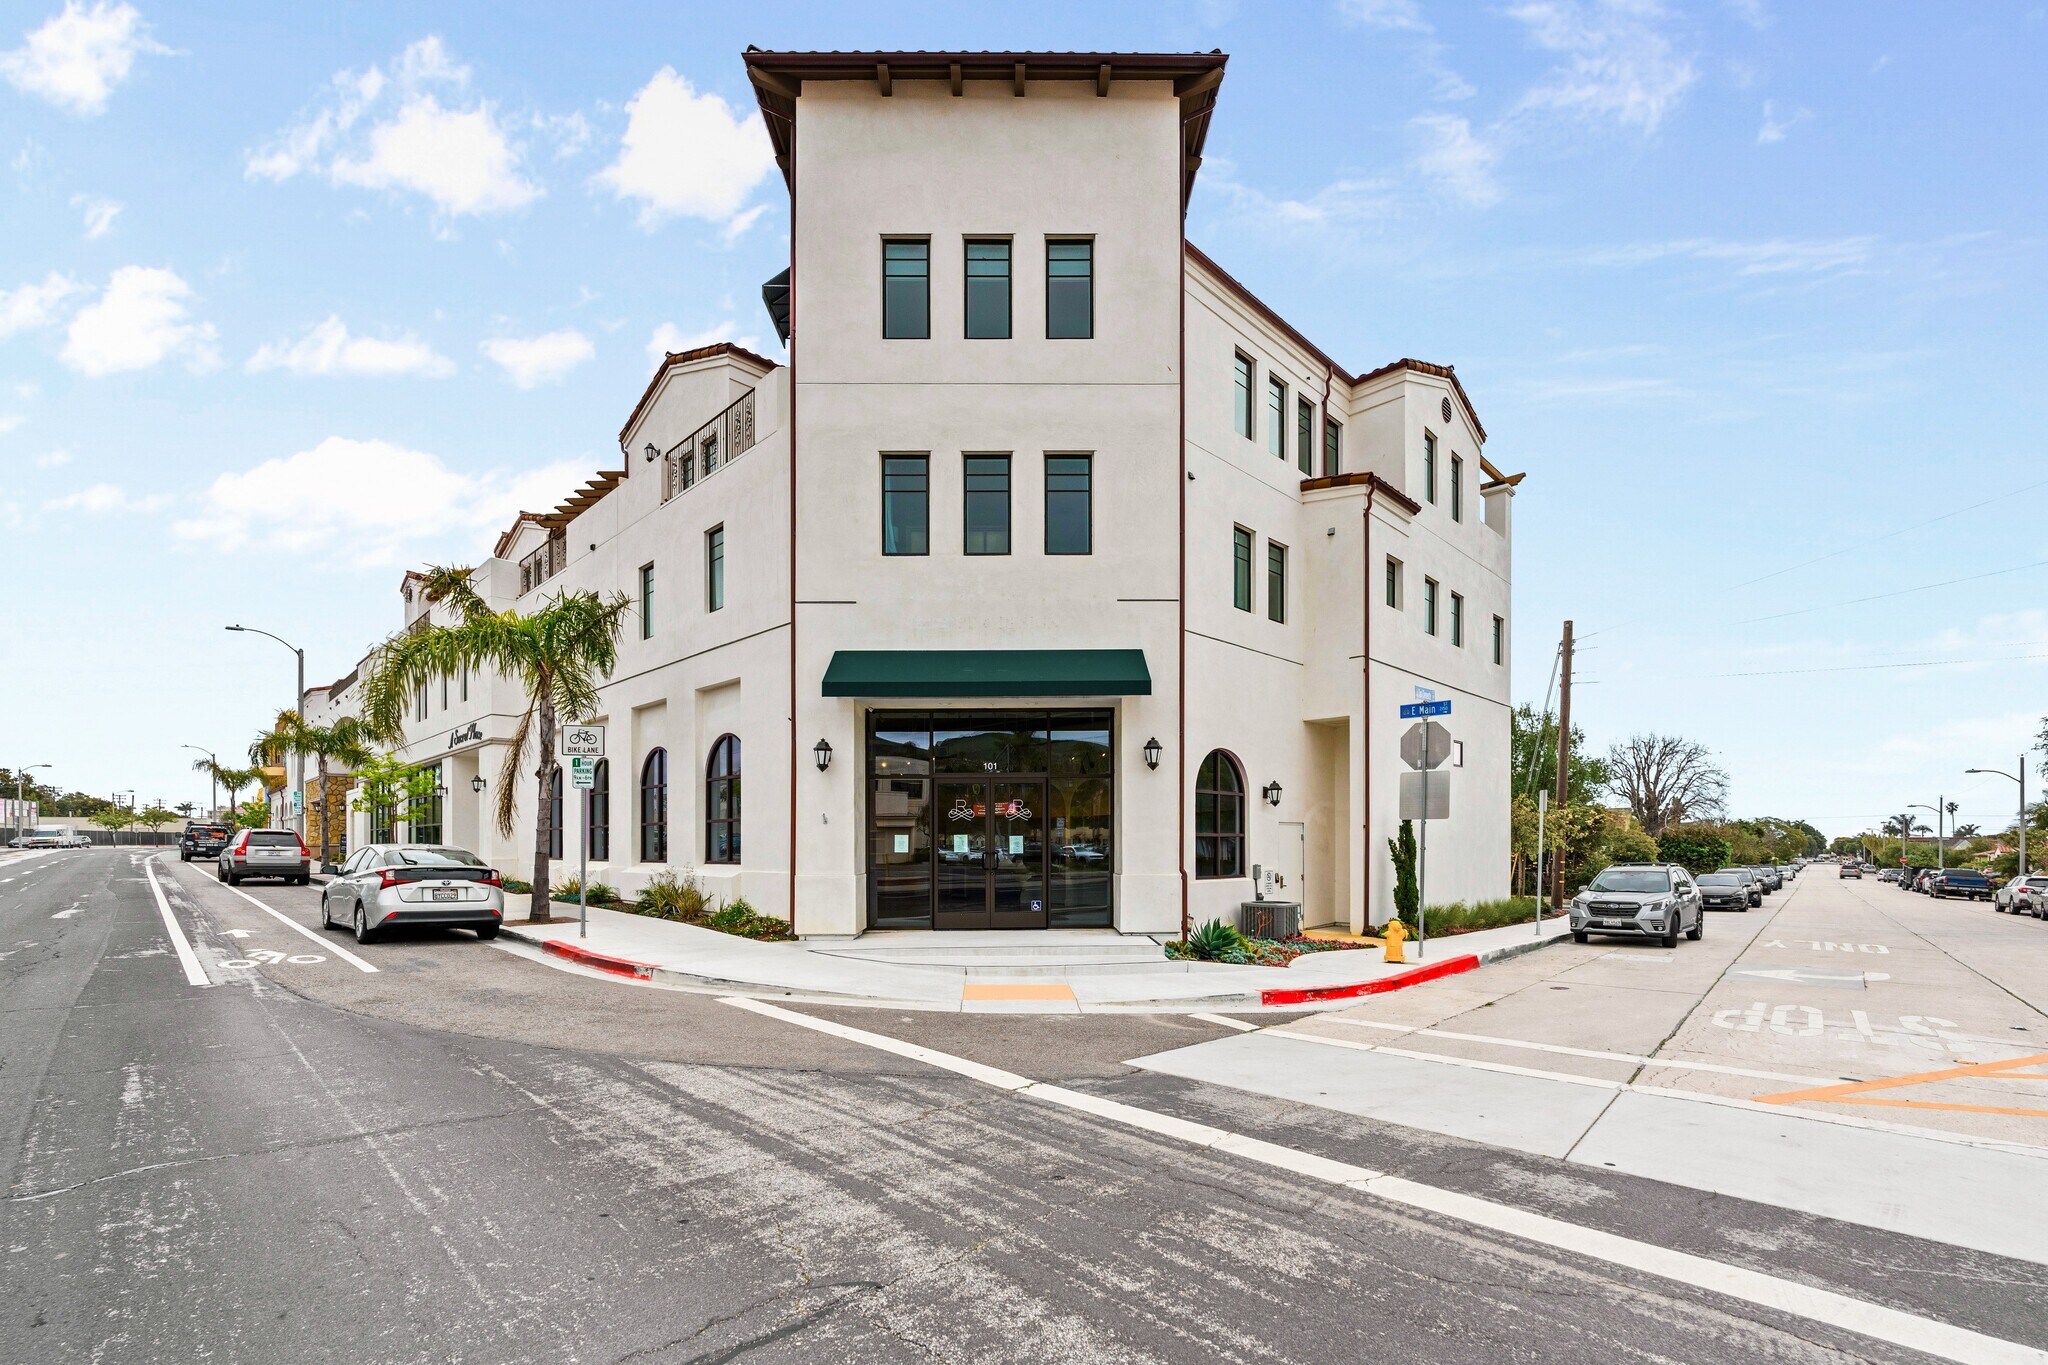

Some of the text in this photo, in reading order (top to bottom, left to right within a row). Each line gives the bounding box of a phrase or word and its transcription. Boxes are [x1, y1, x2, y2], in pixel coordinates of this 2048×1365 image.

[1411, 705, 1436, 716] E Main
[983, 762, 997, 770] 101
[1763, 939, 1891, 954] ONLY
[1711, 1002, 1977, 1053] STOP
